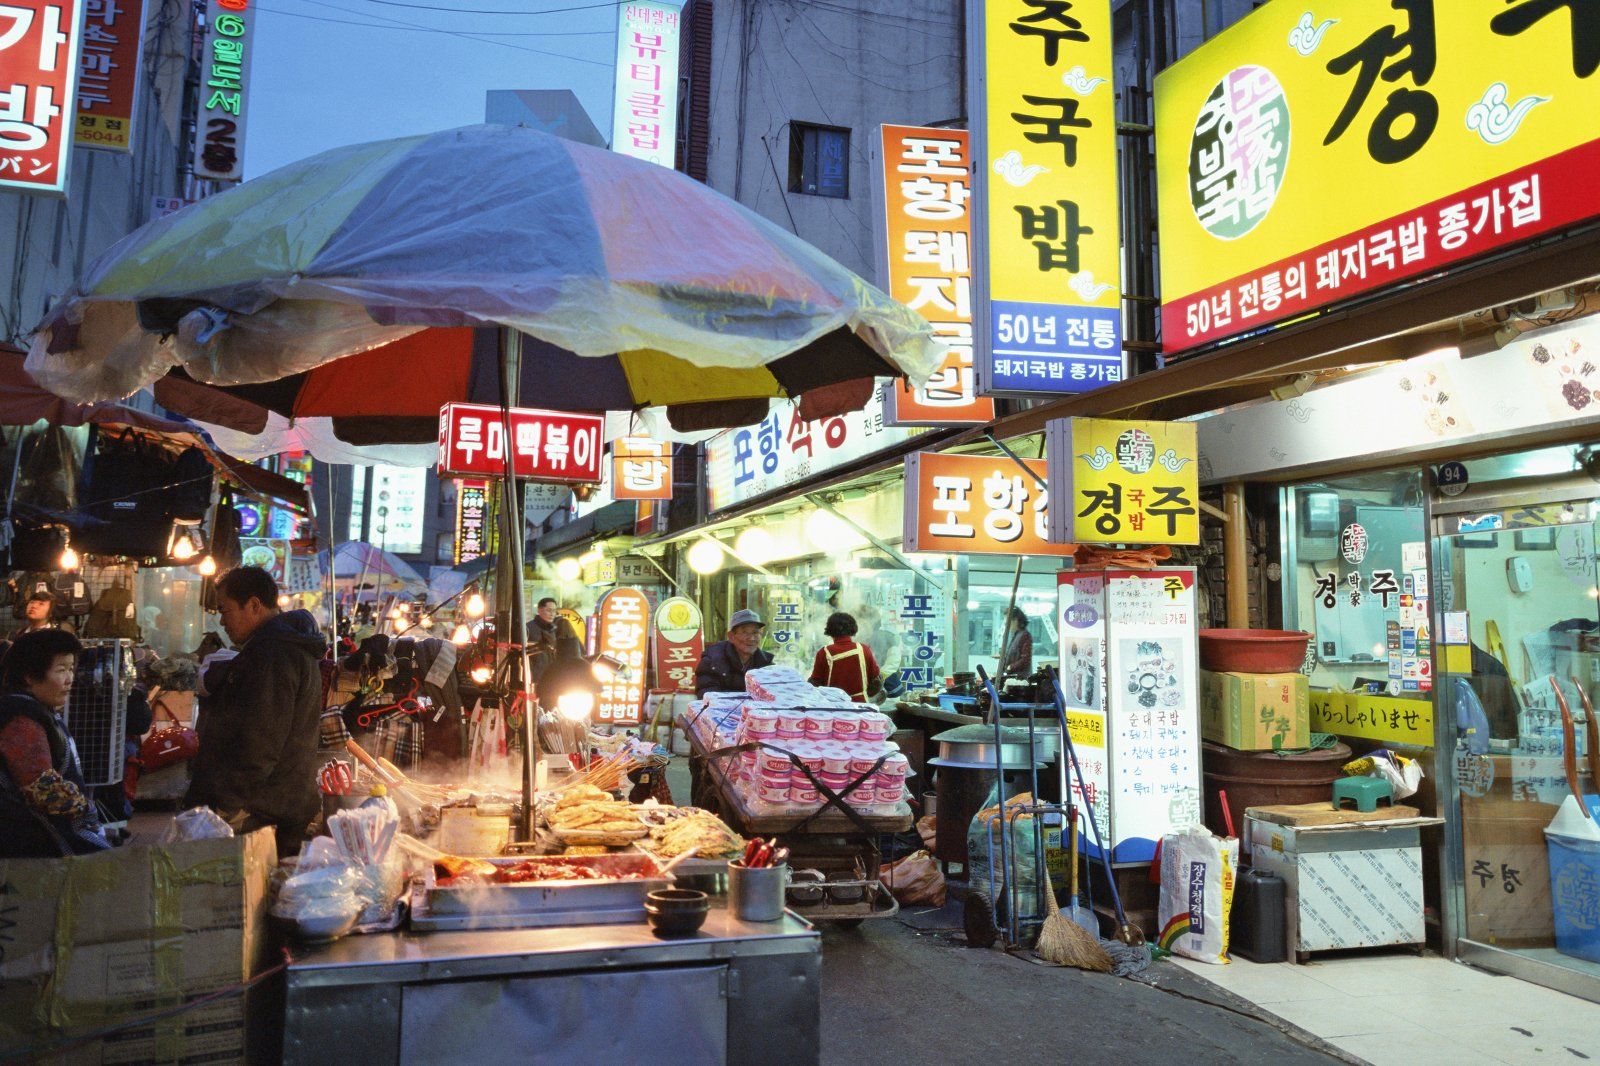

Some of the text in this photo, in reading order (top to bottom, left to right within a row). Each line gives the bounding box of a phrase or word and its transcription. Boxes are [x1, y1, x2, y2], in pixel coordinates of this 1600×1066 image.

[625, 5, 679, 28] 신데렐라
[0, 4, 67, 151] 가방
[626, 31, 667, 150] 뷰티클럽
[0, 156, 52, 176] バン
[1187, 173, 1541, 336] 50년 전통의 돼지국밥 종가집
[997, 313, 1116, 349] 50년 전통
[994, 358, 1121, 382] 돼지국밥 종가집
[1444, 467, 1461, 482] 94
[1126, 488, 1146, 532] 국밥
[606, 596, 643, 649] 포항
[1260, 704, 1293, 743] 부추
